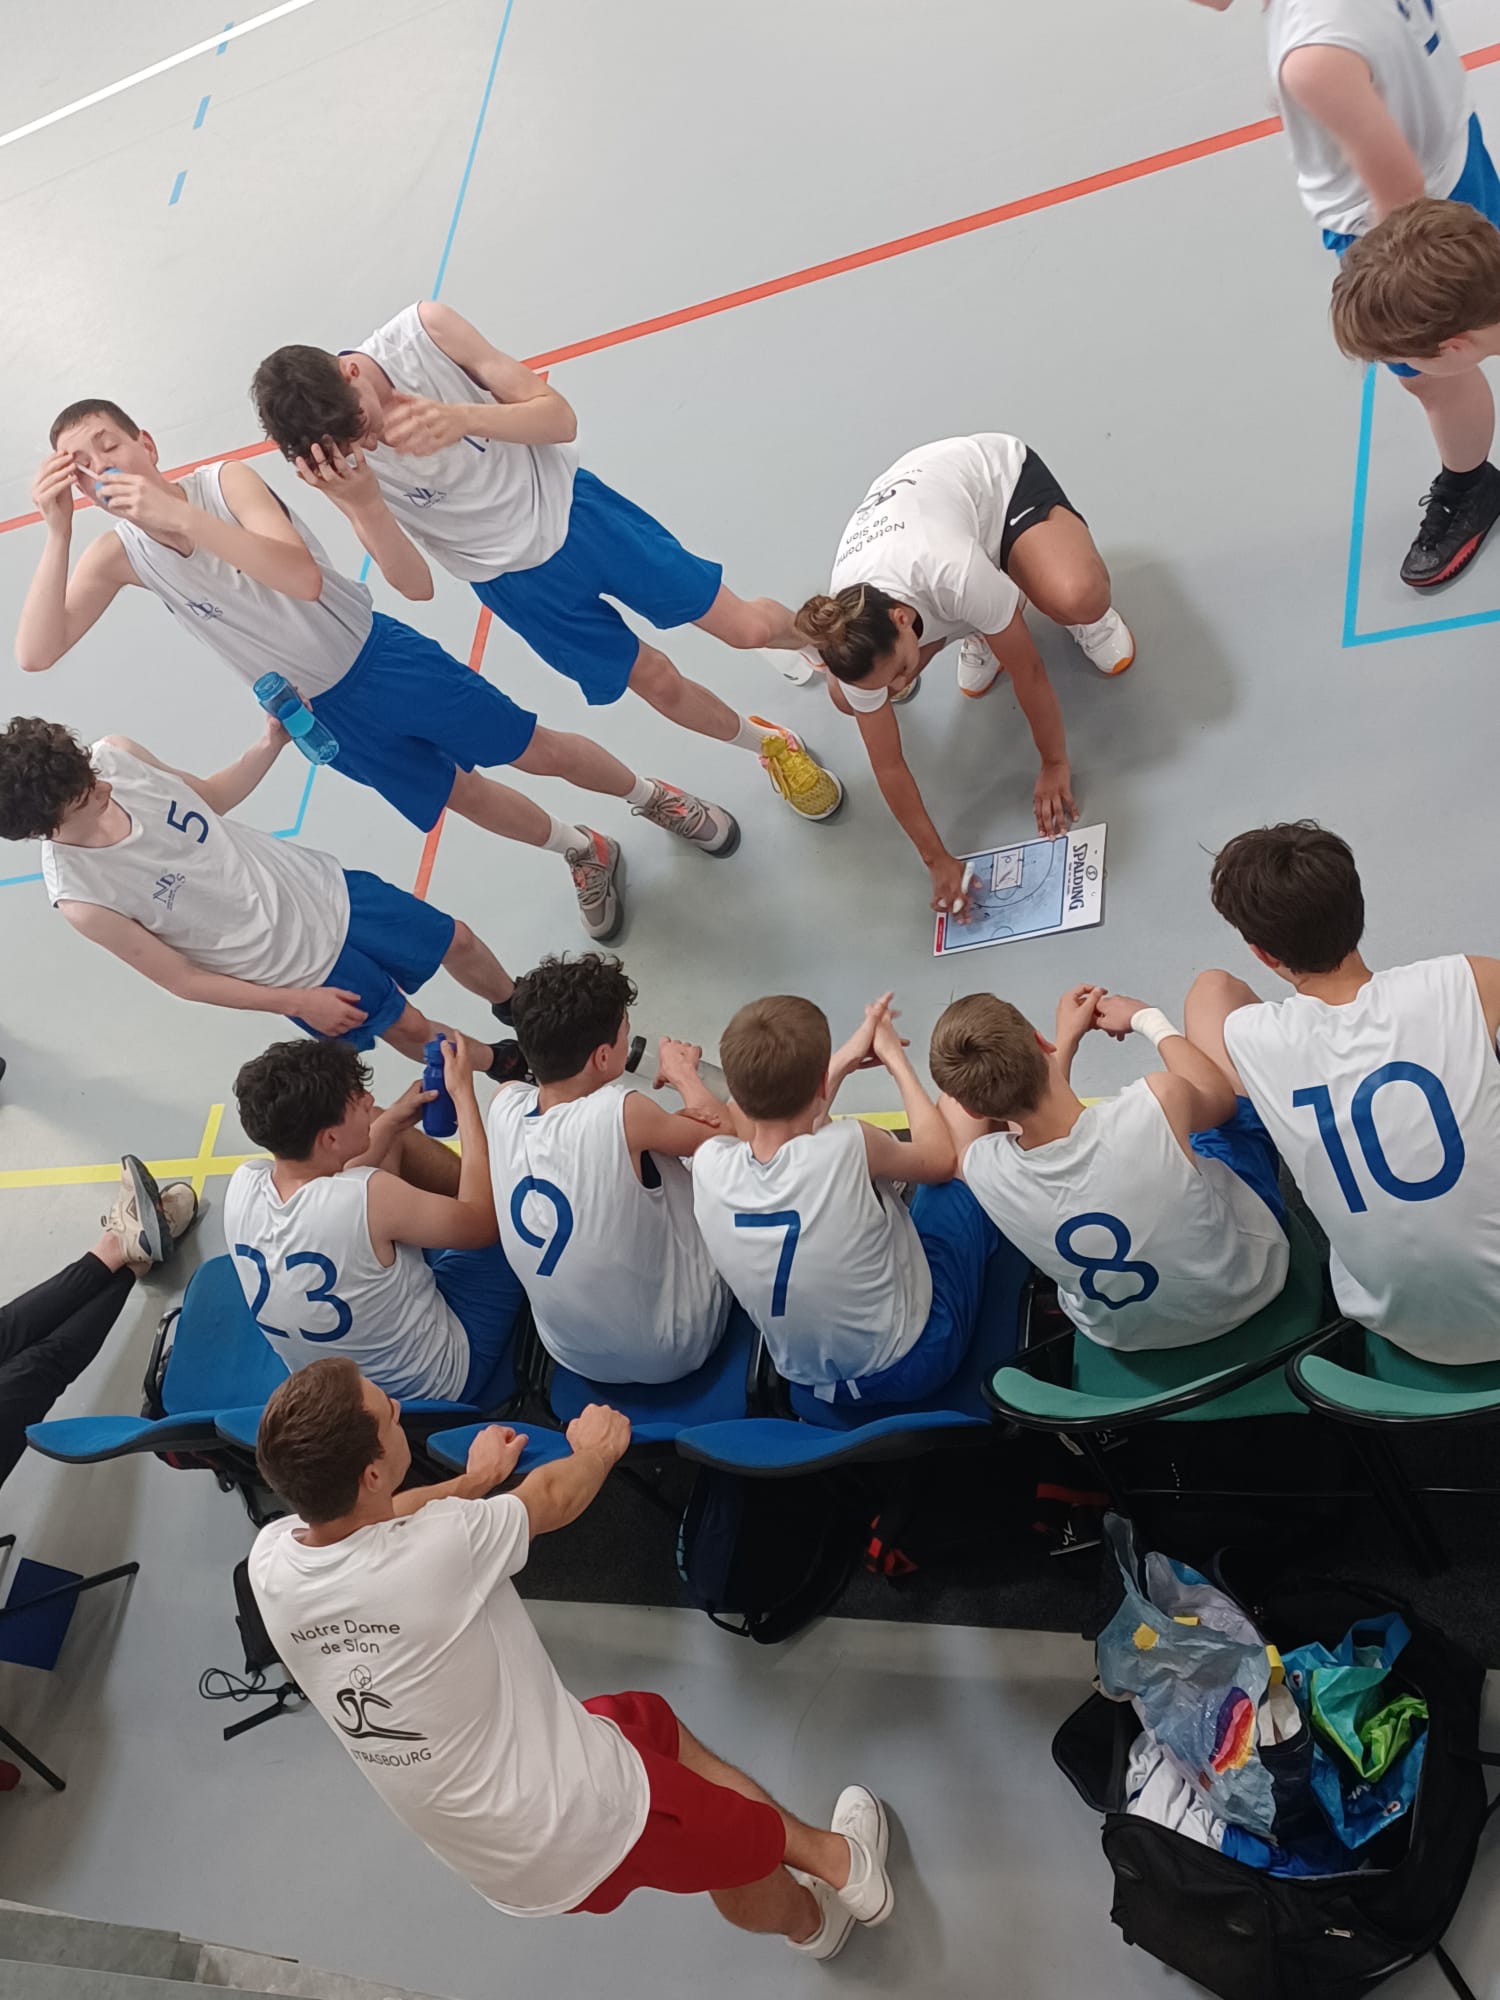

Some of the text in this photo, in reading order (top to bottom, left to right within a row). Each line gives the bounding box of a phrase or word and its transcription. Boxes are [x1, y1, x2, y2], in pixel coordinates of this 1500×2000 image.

[836, 541, 863, 568] Dam
[166, 800, 209, 844] 5
[1069, 843, 1088, 911] SPALDING
[1292, 1061, 1465, 1213] 10
[510, 1176, 574, 1276] 9
[734, 1210, 801, 1316] 7
[1055, 1212, 1159, 1310] 8
[235, 1243, 353, 1342] 23
[290, 1619, 401, 1644] Notre Dame
[321, 1643, 341, 1655] de
